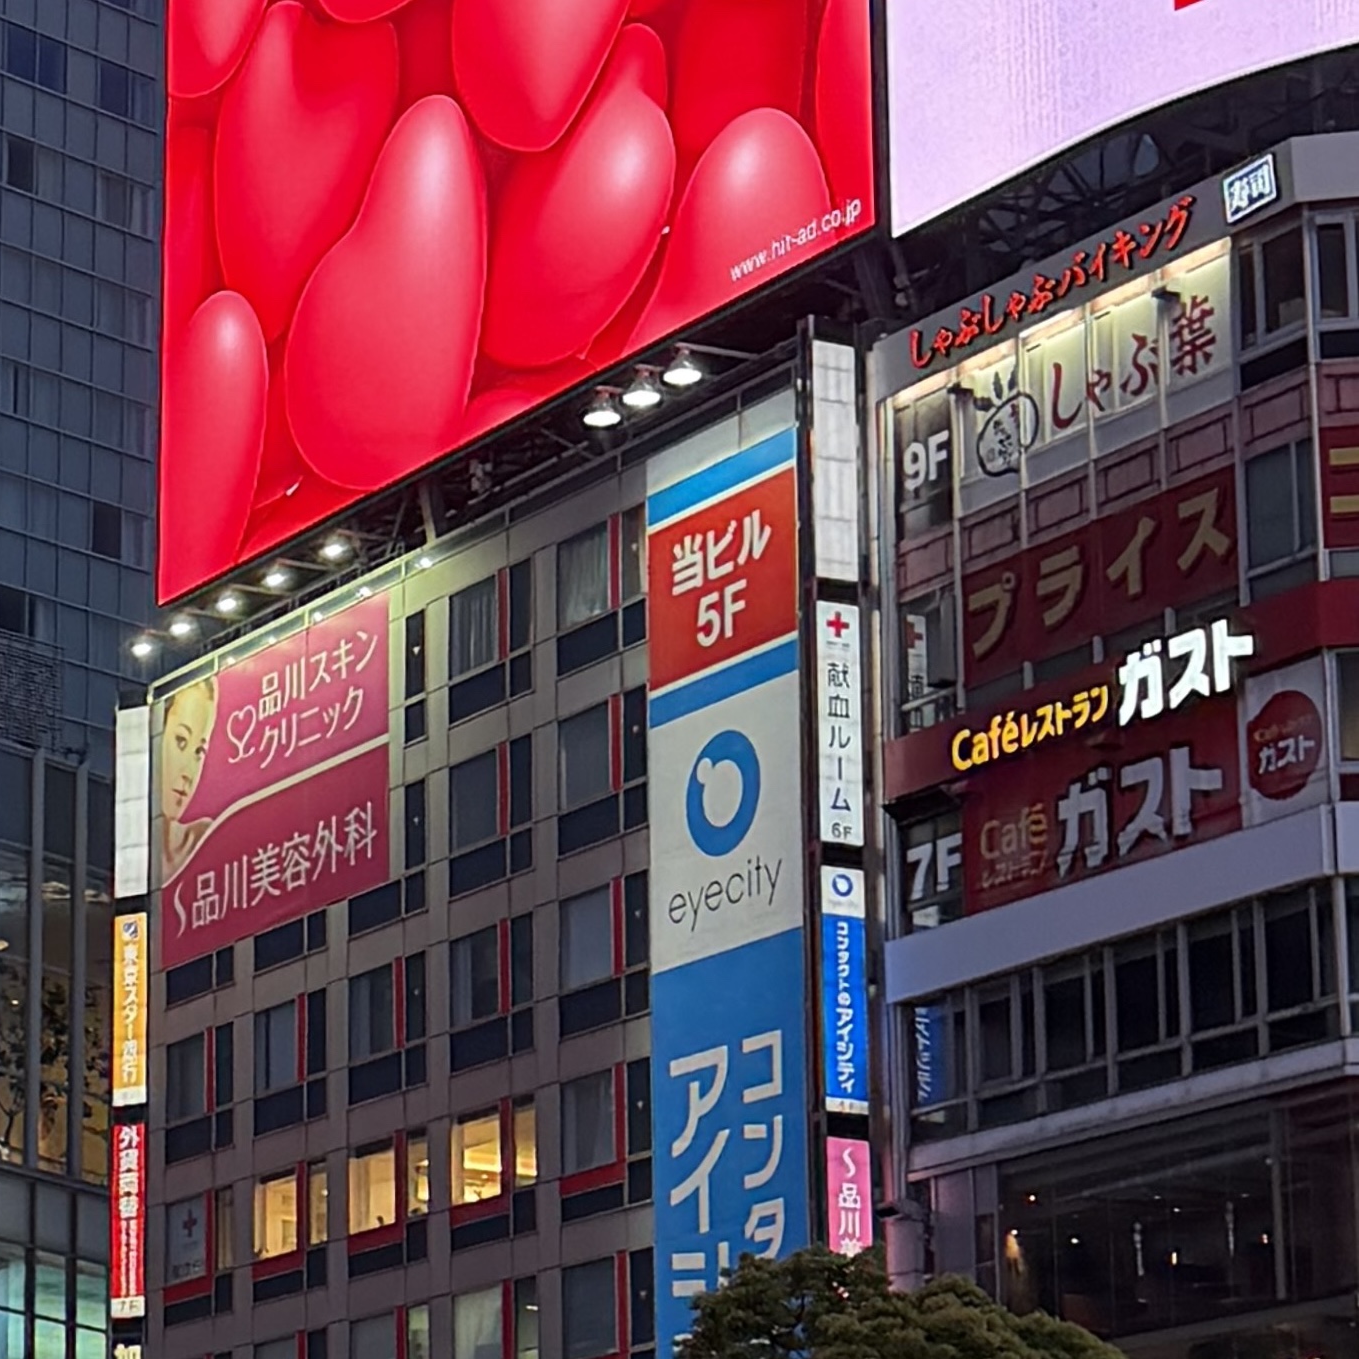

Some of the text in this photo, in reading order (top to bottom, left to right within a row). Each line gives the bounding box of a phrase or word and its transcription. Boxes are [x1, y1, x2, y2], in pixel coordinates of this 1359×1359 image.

[1227, 164, 1272, 216] 寿司
[730, 199, 862, 281] www.hit-ad.co.jp
[908, 195, 1197, 369] しゃぶしゃぶバイキング
[1052, 293, 1217, 430] しゃぶ葉
[903, 430, 950, 494] 9F
[672, 509, 772, 596] 当ビル
[967, 488, 1232, 658] プライス
[695, 578, 748, 649] 5F
[258, 629, 379, 719] 品川スキン
[1118, 618, 1255, 727] ガスト
[258, 686, 365, 770] クリニック
[827, 661, 853, 812] 献血ルーム
[1258, 734, 1316, 775] ガスト
[831, 822, 853, 840] 6F
[1056, 746, 1224, 880] ガスト
[191, 801, 378, 930] 品川美容外科
[667, 855, 782, 932] eyecity
[906, 834, 963, 901] 7F
